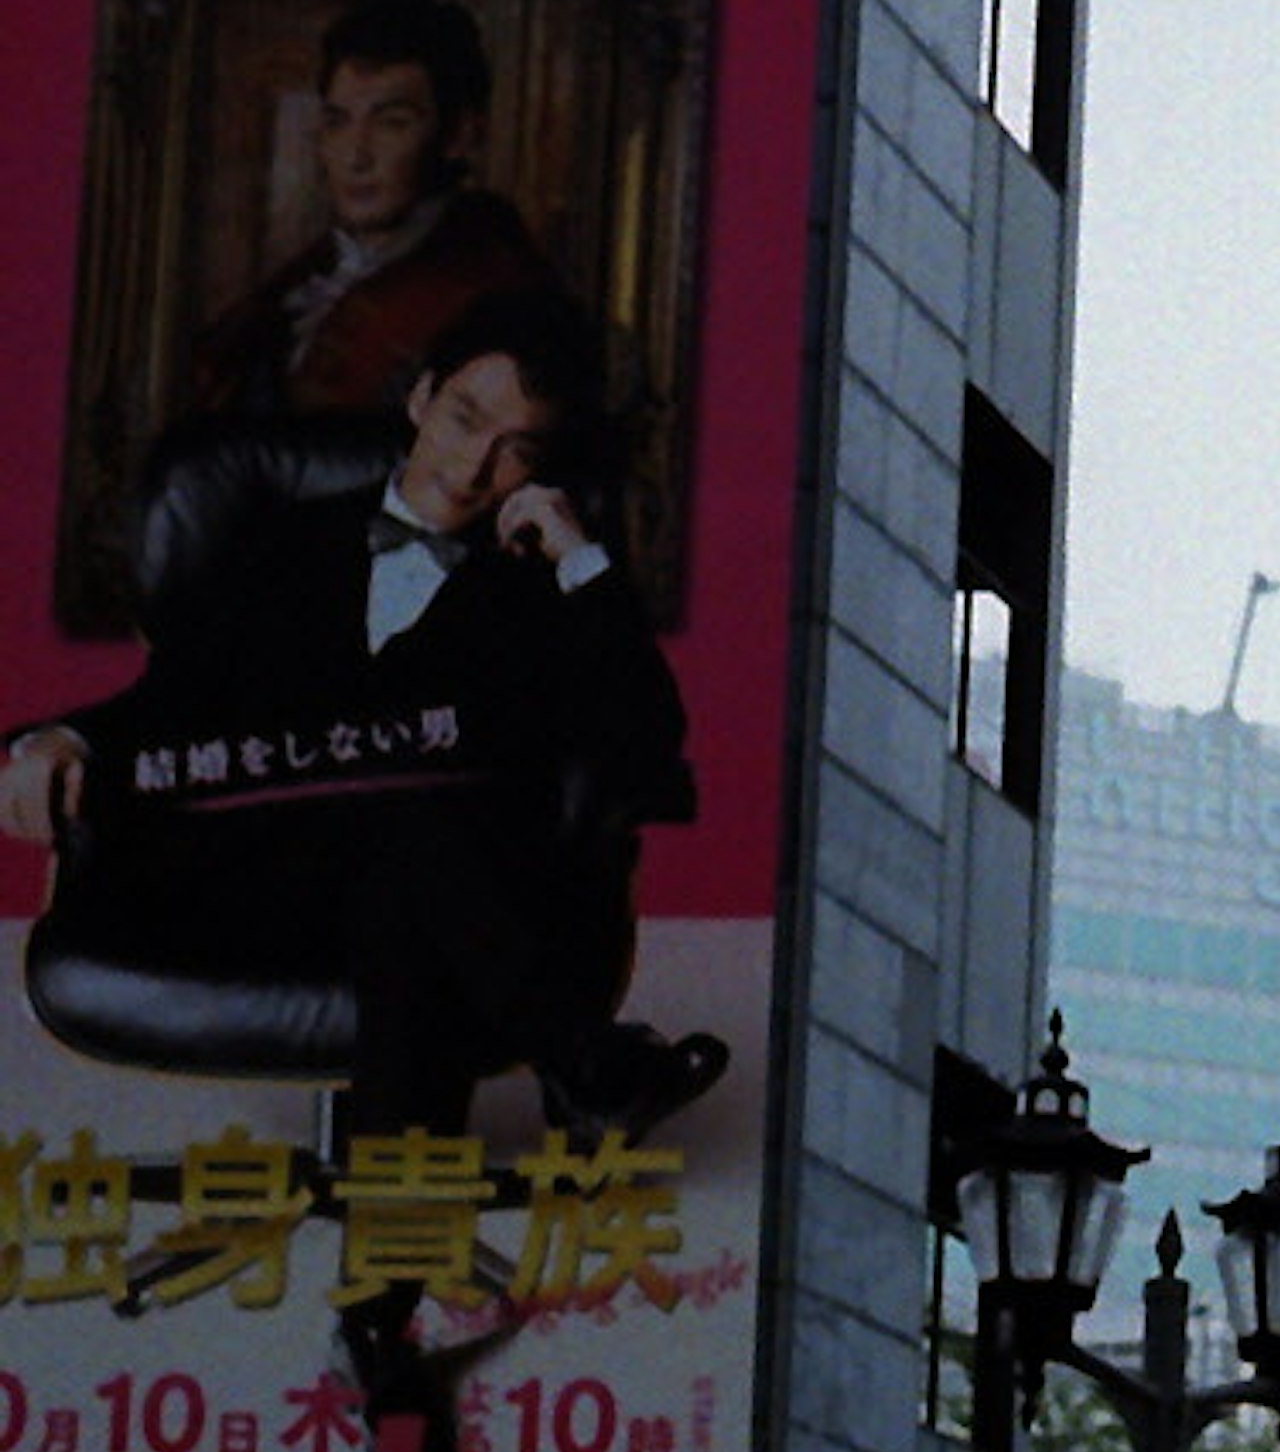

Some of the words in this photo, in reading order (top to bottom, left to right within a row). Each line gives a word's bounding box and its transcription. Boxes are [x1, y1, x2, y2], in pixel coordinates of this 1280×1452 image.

[134, 705, 459, 791] 結婚をしない男
[0, 1124, 685, 1313] 独身貴族
